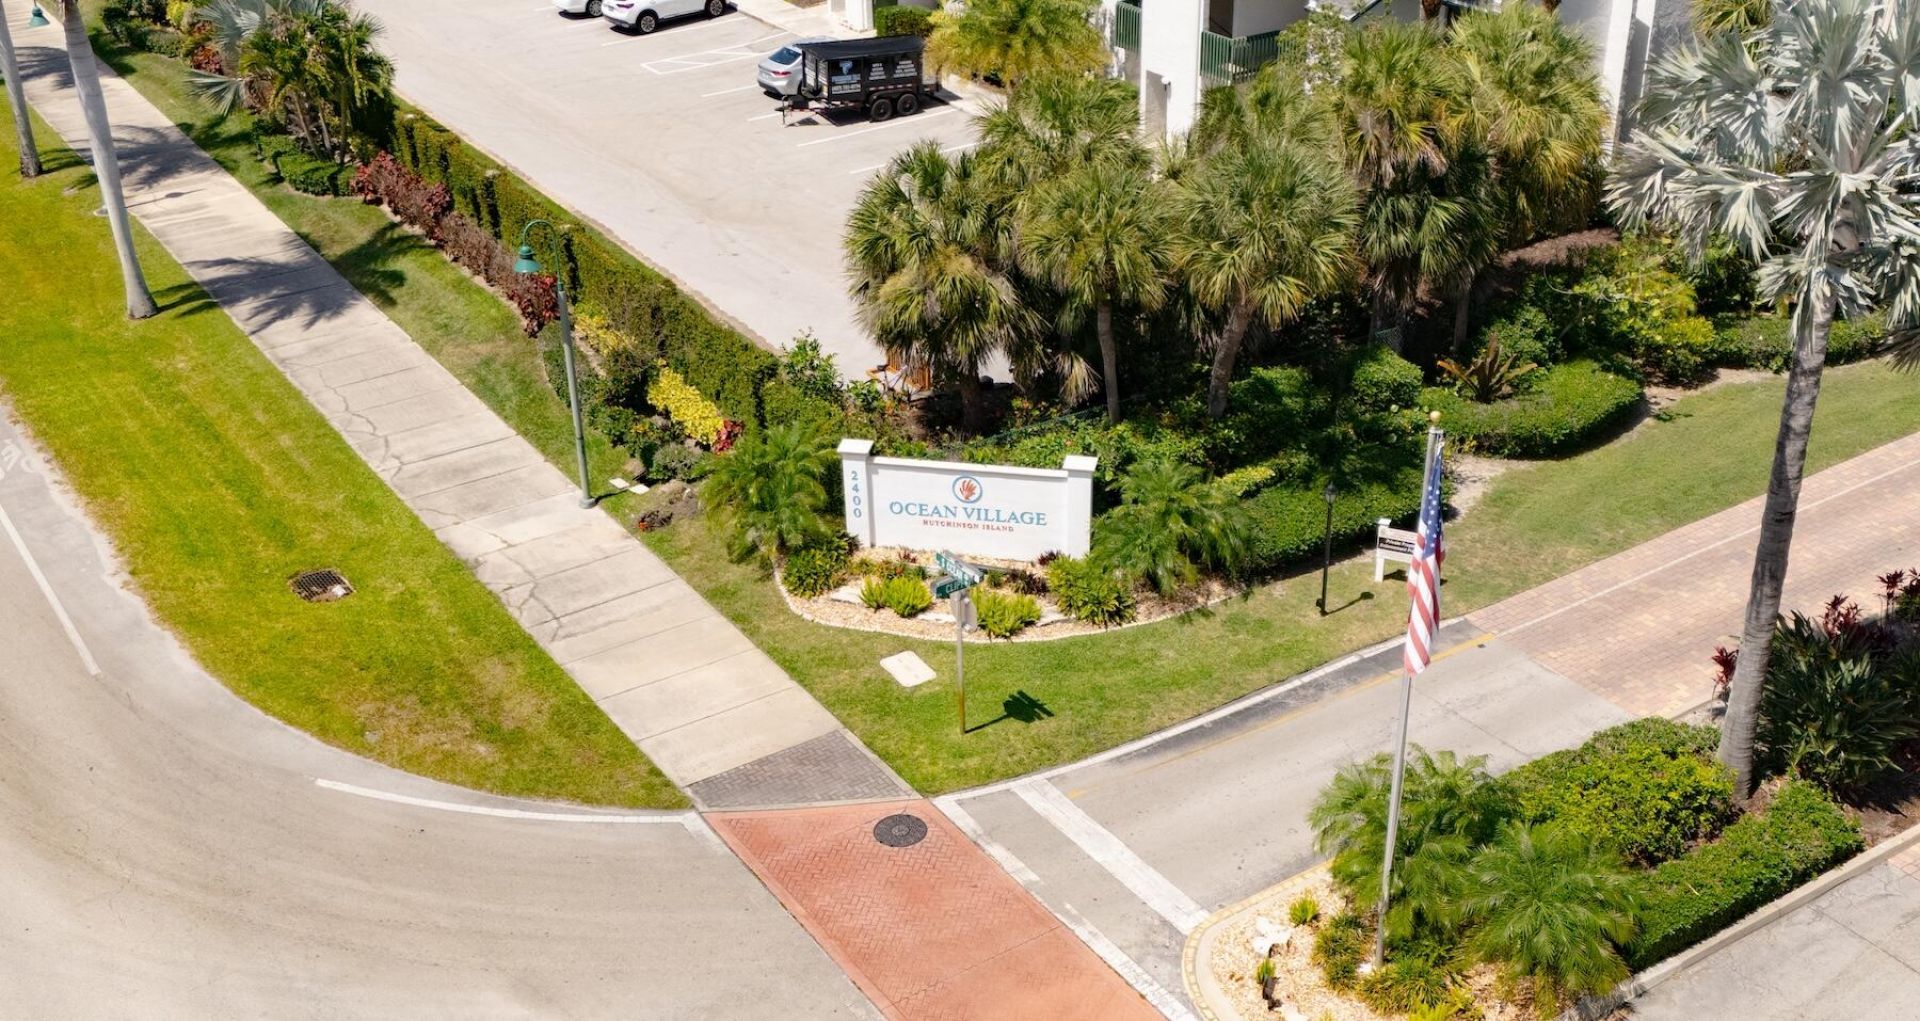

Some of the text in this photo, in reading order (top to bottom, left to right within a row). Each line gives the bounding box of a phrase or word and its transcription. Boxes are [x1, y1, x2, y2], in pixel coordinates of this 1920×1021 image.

[851, 470, 862, 518] 2400
[889, 501, 1047, 525] OCEAN VILLAGE
[923, 519, 1014, 532] HUTCHINSON ISLAND
